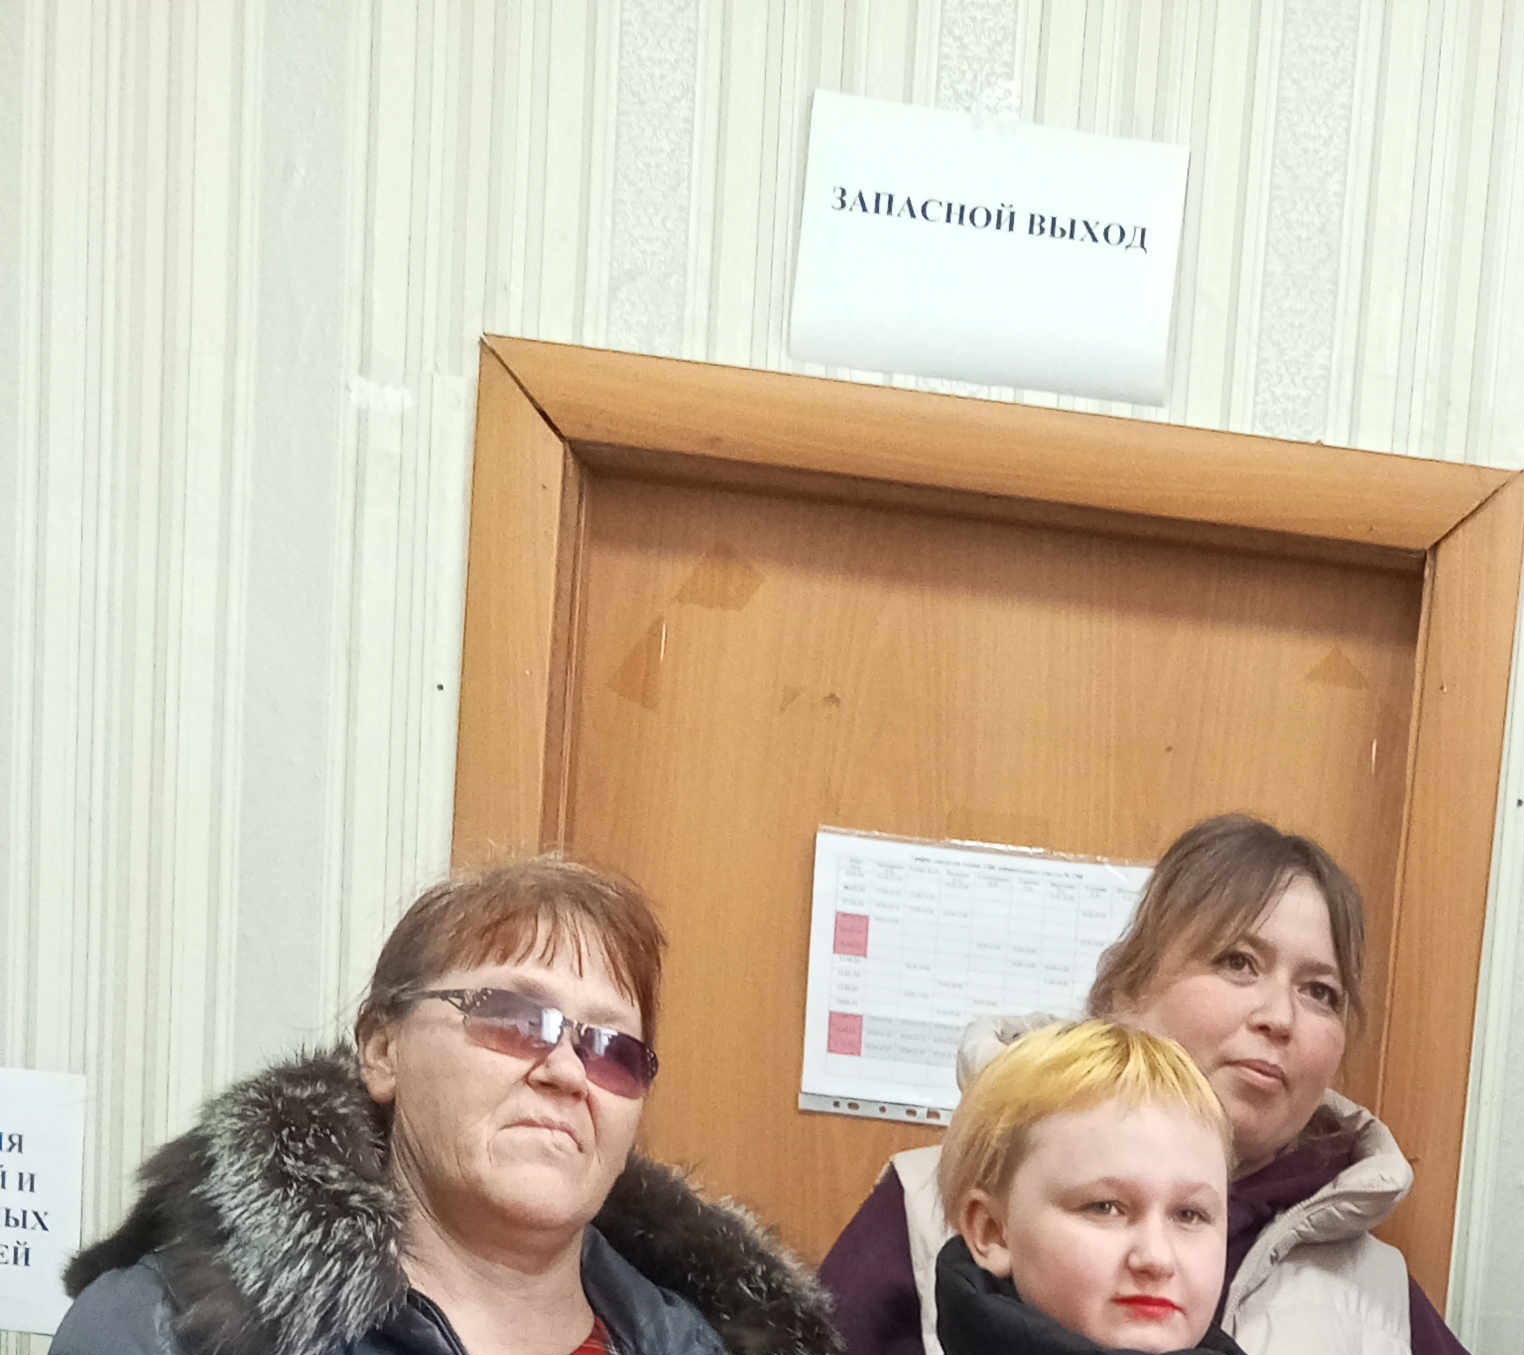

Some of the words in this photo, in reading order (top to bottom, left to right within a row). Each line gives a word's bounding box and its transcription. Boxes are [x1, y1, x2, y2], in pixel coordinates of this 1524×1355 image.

[831, 185, 1016, 233] ЗАПАСНОЙ
[1027, 213, 1149, 254] ВЫХОД
[0, 1131, 24, 1154] Я
[0, 1206, 49, 1231] ЫХ
